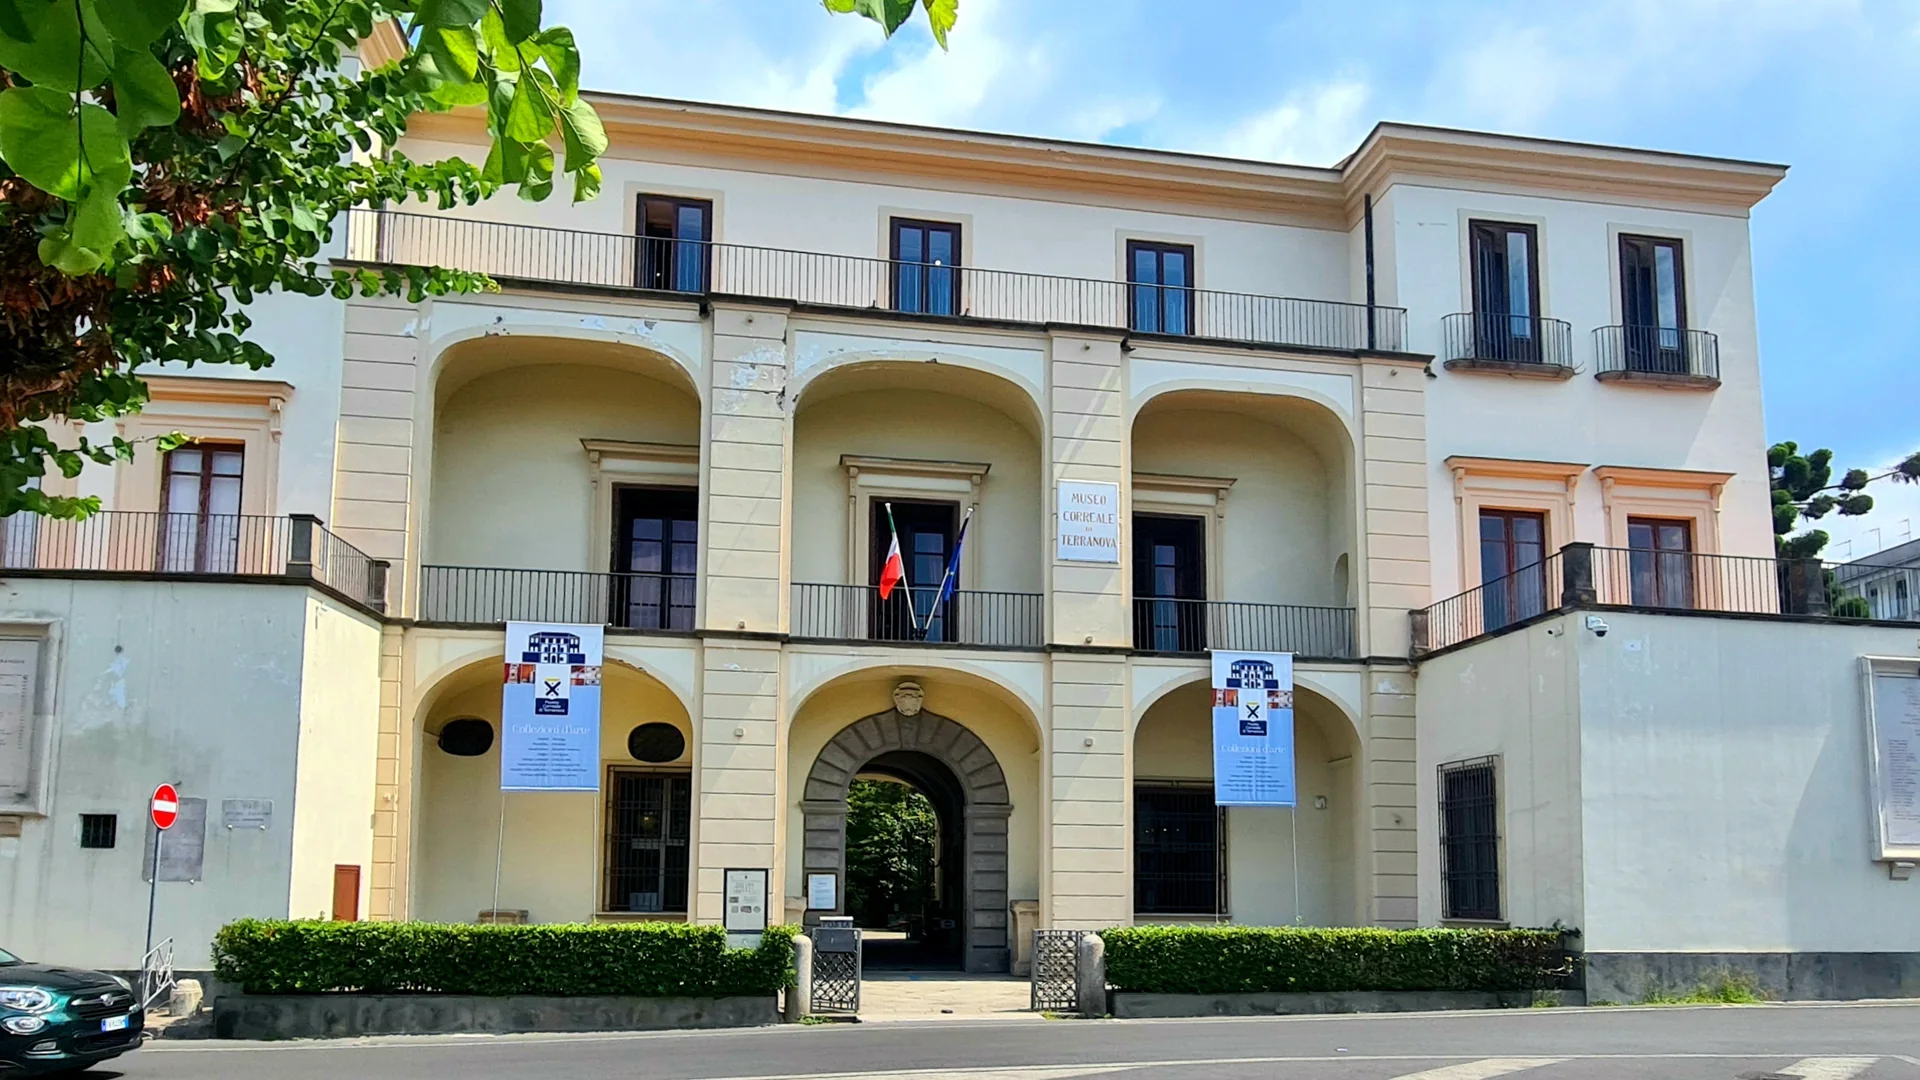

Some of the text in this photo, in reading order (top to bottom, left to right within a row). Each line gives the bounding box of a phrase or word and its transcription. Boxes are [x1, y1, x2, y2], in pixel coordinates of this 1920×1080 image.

[1072, 493, 1107, 505] MUSEO
[1063, 511, 1115, 524] CORREALE
[1062, 534, 1117, 548] TERRANOVA
